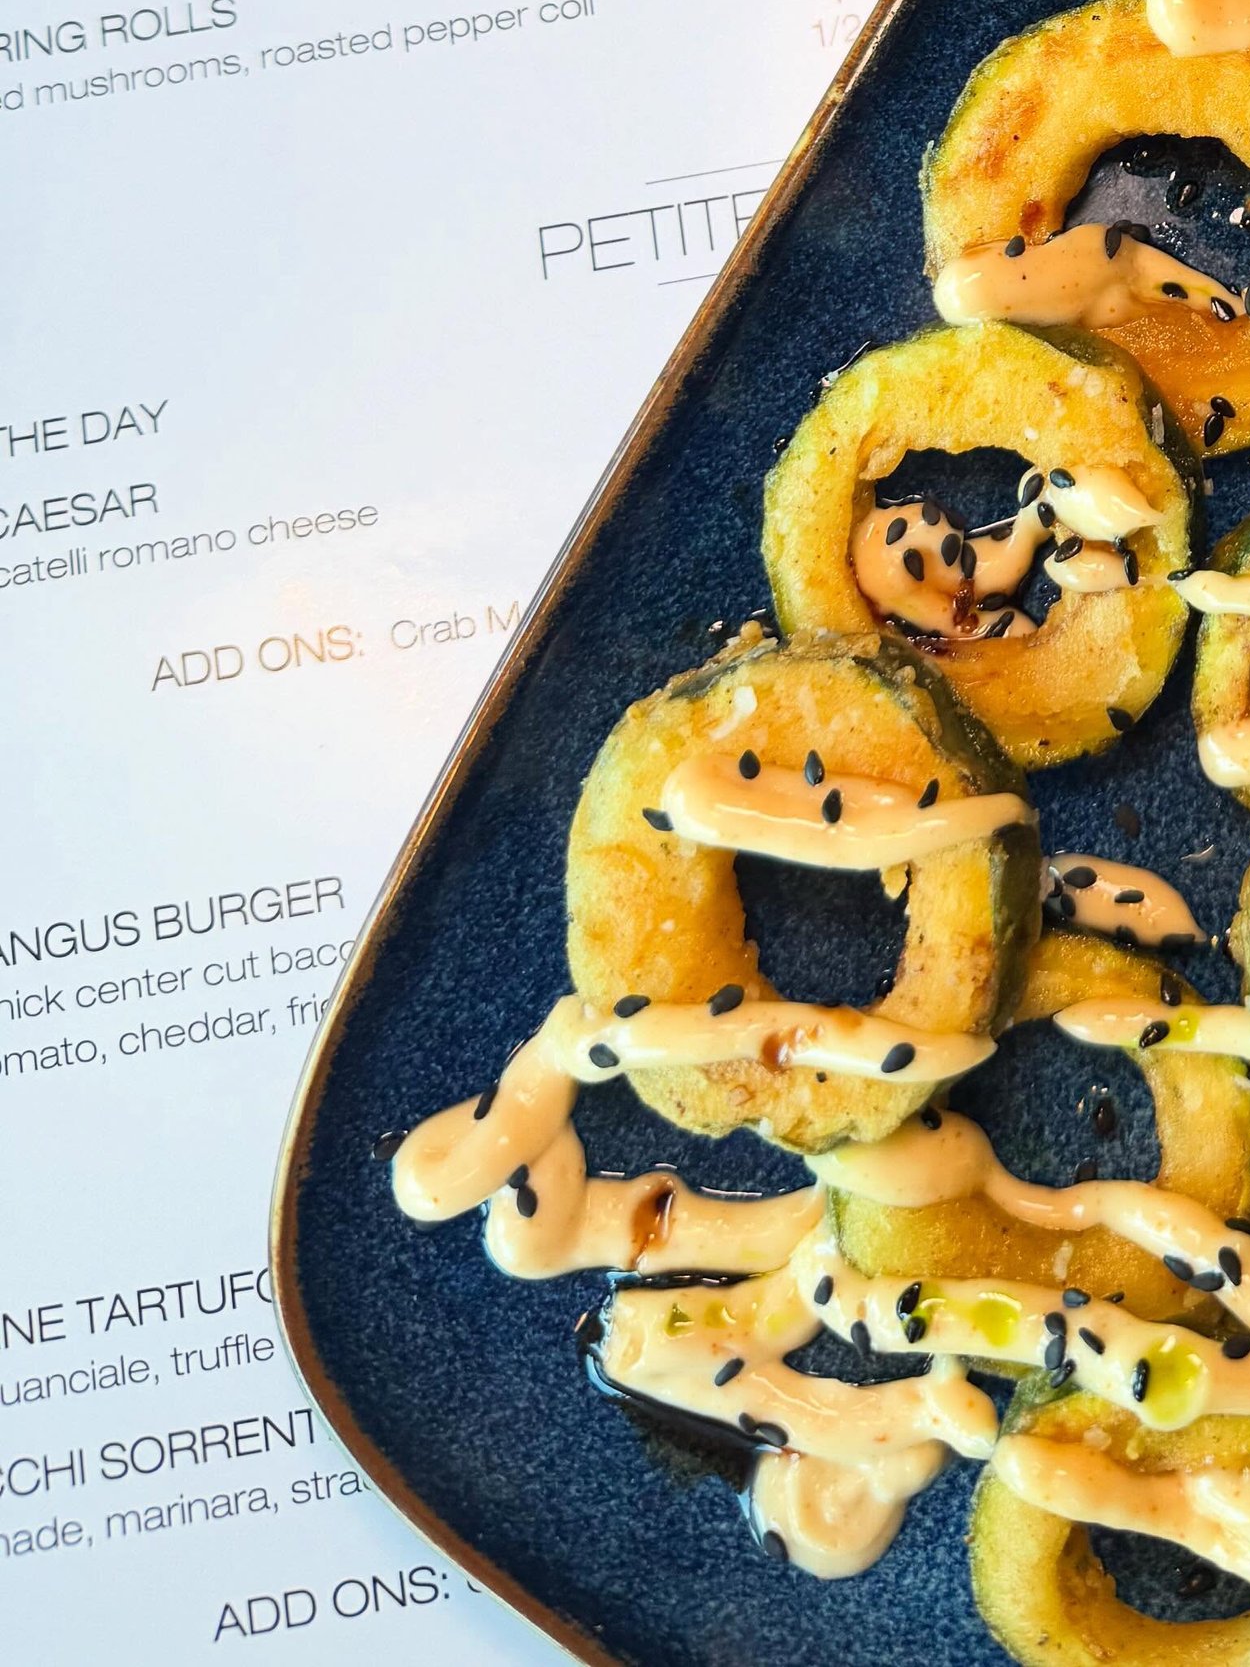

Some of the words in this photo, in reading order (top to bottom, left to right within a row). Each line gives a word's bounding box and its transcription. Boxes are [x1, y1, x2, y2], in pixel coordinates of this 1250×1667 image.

[0, 83, 24, 110] d
[35, 55, 248, 105] mushrooms,
[261, 23, 392, 68] roasted
[404, 7, 528, 52] pepper
[0, 417, 69, 456] HE
[81, 400, 168, 445] DAY
[99, 530, 236, 571] romano
[248, 506, 378, 545] cheese
[152, 645, 243, 691] ADD
[258, 625, 364, 672] ONS:
[391, 612, 476, 649] Crab
[154, 877, 344, 940] BURGER
[76, 968, 192, 1008] center
[203, 951, 260, 986] cut
[0, 1038, 106, 1076] mato,
[119, 1009, 275, 1055] cheddar,
[0, 1356, 159, 1406] uanciale,
[170, 1334, 274, 1375] truffle
[0, 1449, 85, 1497] CHI
[100, 1408, 332, 1479] SORRENT
[107, 1488, 278, 1538] marinara,
[214, 1590, 316, 1642] ADD
[333, 1566, 449, 1617] ONS:
